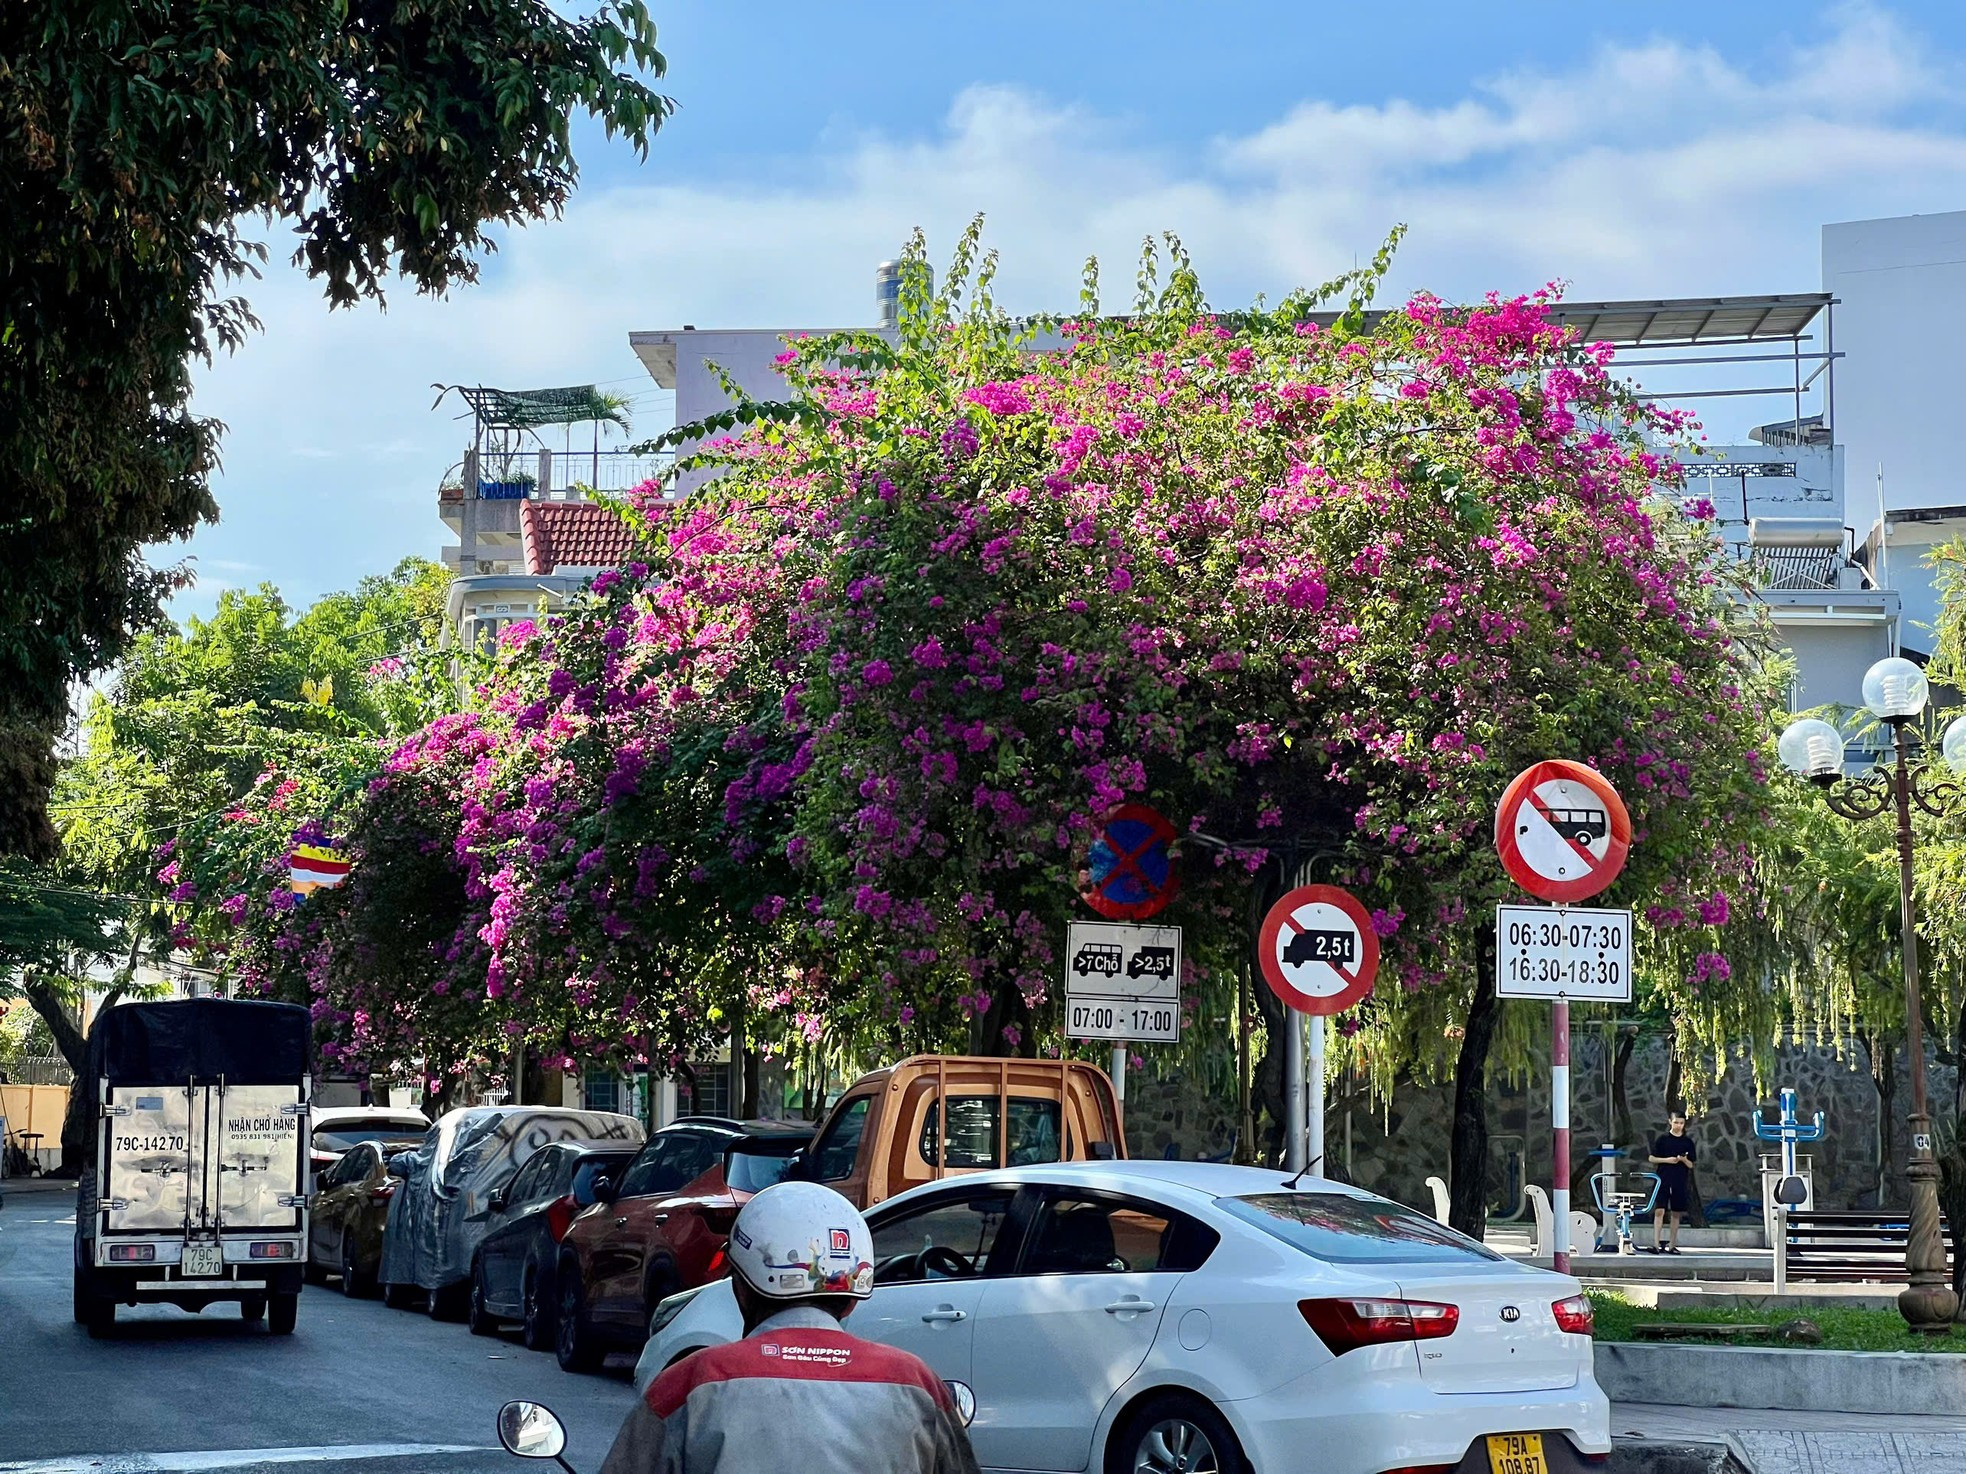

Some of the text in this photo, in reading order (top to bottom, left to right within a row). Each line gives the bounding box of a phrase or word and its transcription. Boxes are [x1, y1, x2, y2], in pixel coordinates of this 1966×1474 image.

[1510, 923, 1620, 949] 06:30-07:30
[1095, 954, 1118, 971] Chỗ
[1509, 957, 1619, 984] 16:30-18:30
[1074, 1007, 1112, 1029] 07:00
[1132, 1009, 1171, 1031] 17:00
[228, 1114, 295, 1133] NHẬN CHỞ HÀNG
[116, 1136, 183, 1151] 79C-142.70
[191, 1249, 212, 1261] 79C
[1503, 1309, 1518, 1319] KIA
[781, 1346, 850, 1355] SƠN NIPPON
[1503, 1436, 1528, 1456] 79A
